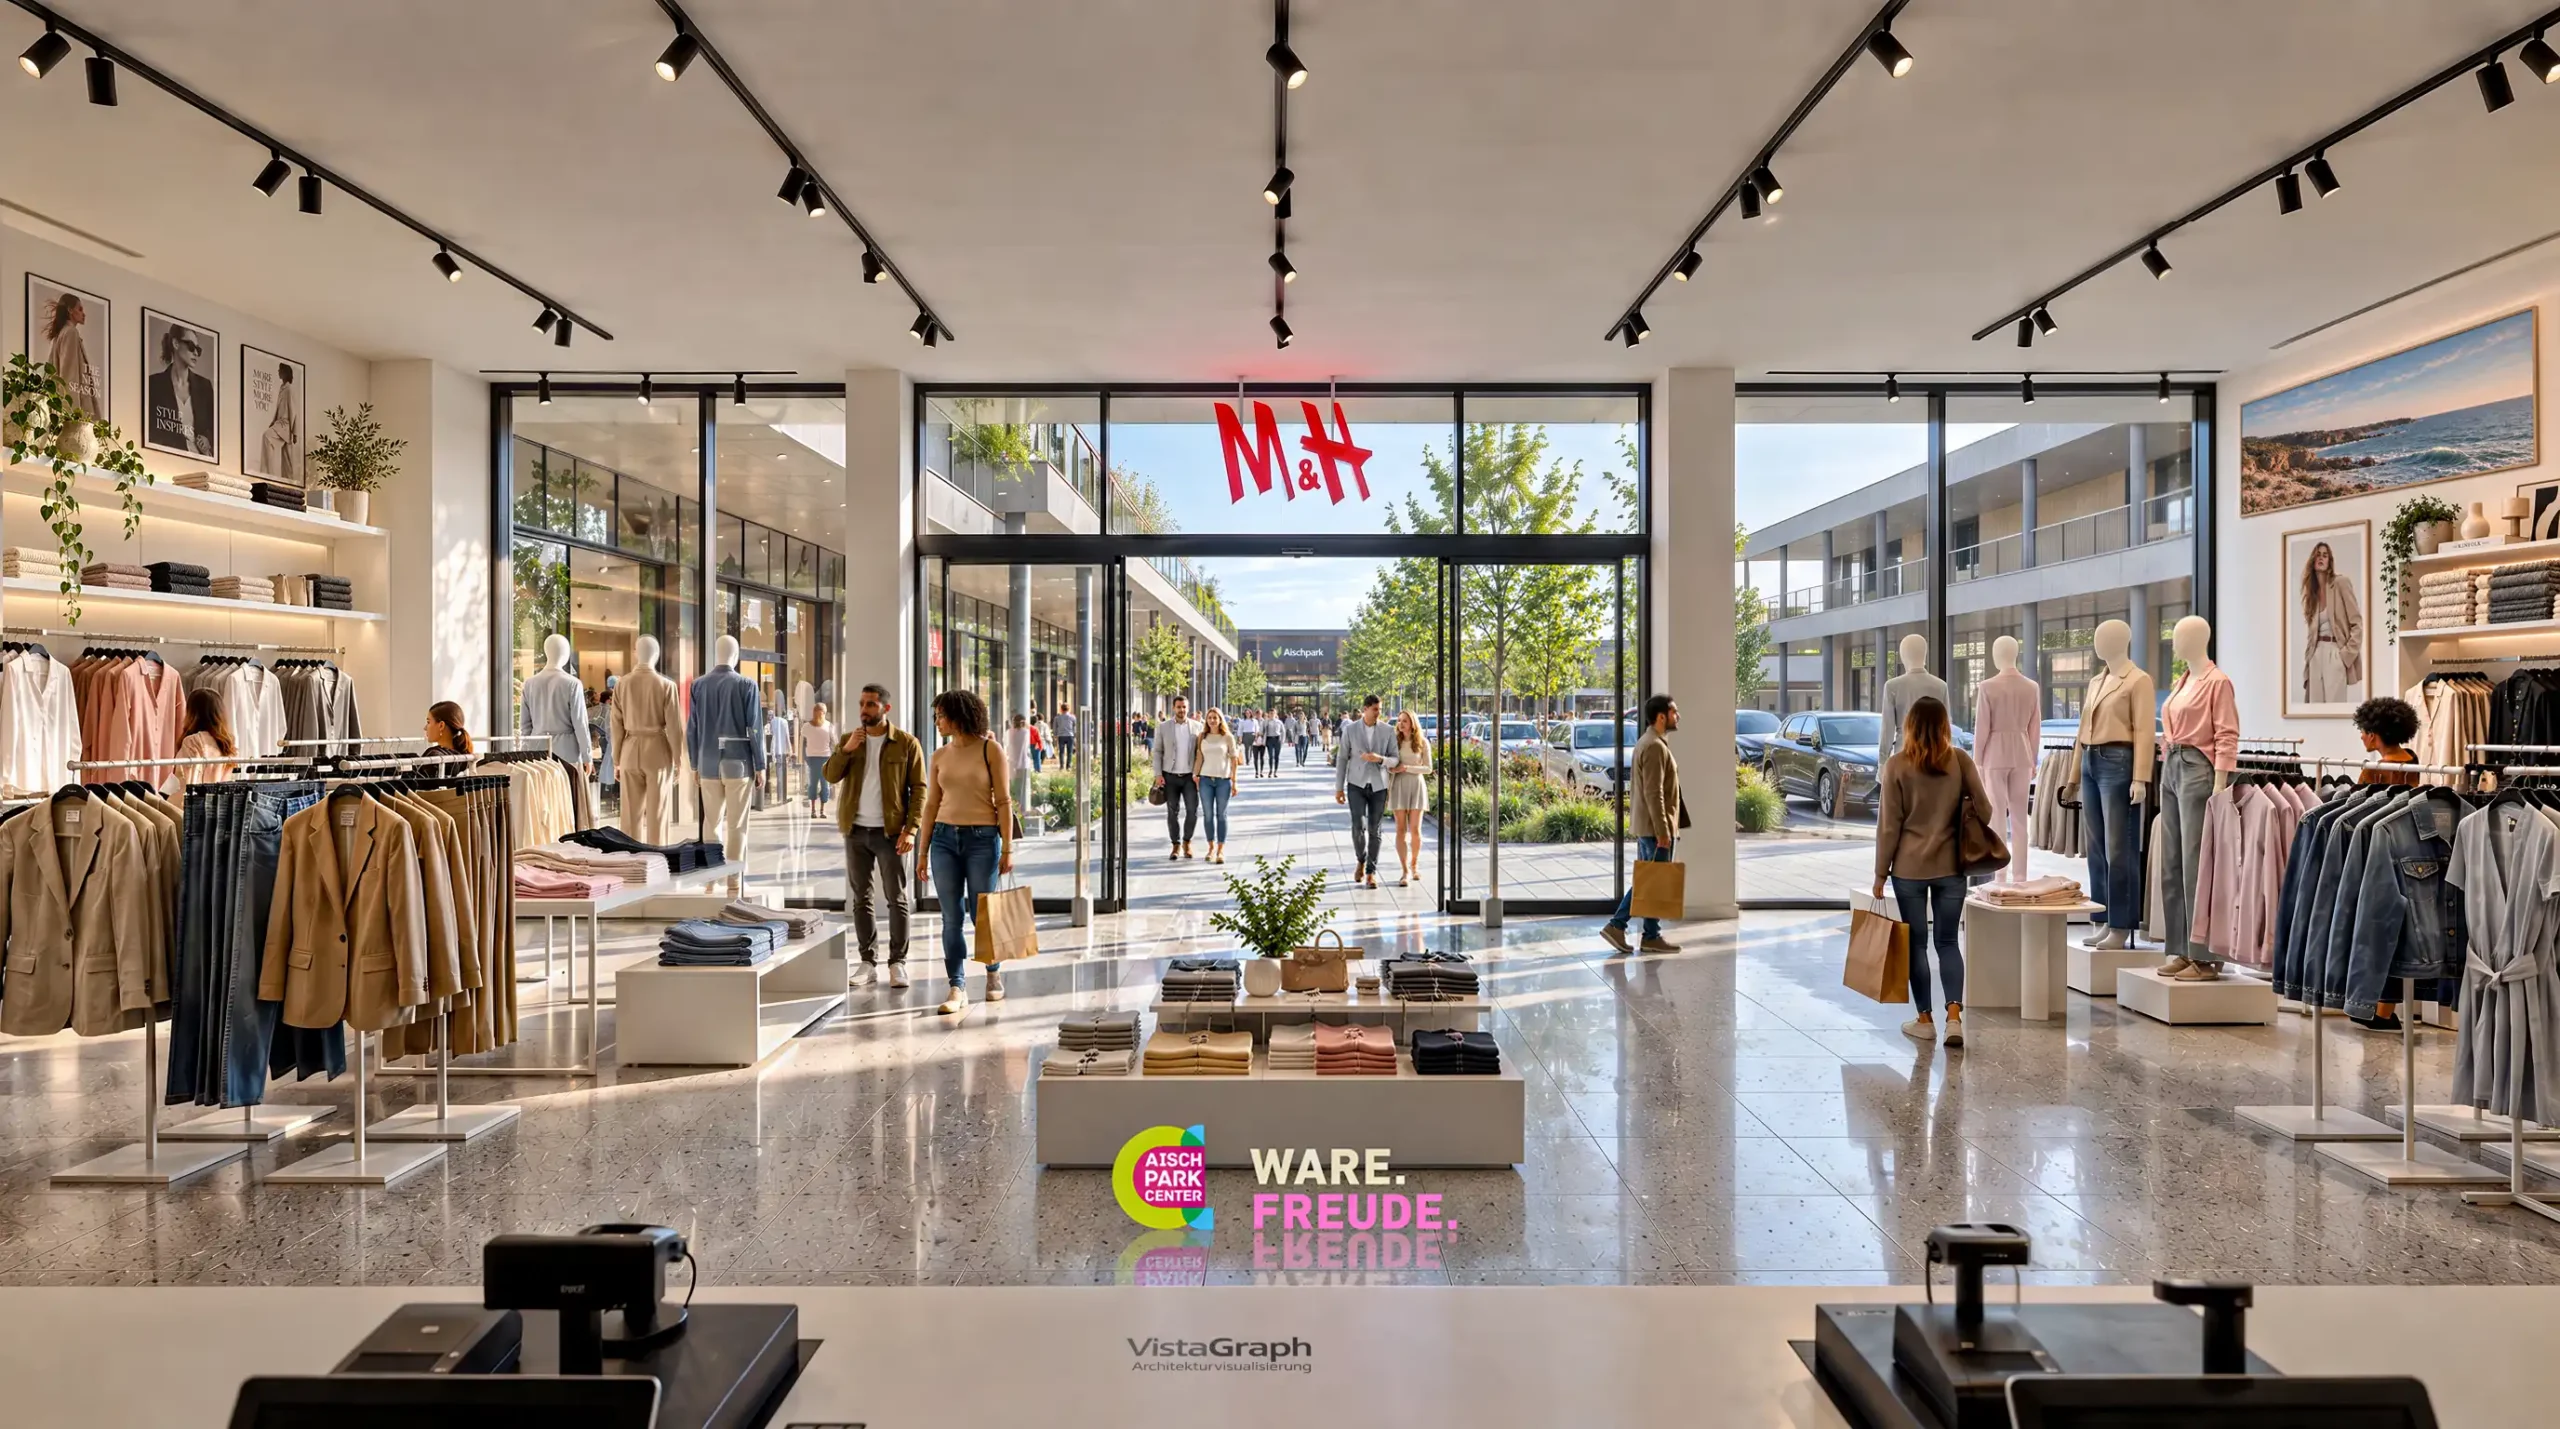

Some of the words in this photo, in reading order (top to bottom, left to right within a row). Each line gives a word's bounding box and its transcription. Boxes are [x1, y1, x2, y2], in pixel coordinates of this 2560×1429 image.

[83, 363, 100, 376] THE
[253, 369, 272, 382] MORE
[82, 373, 100, 386] NEW
[253, 380, 272, 392] STYLE
[69, 382, 101, 398] SEASON
[253, 389, 272, 403] MORE
[254, 400, 269, 411] YOU
[156, 405, 183, 421] STYLE
[156, 418, 194, 437] INSPIRES
[1283, 648, 1324, 658] Aischpark
